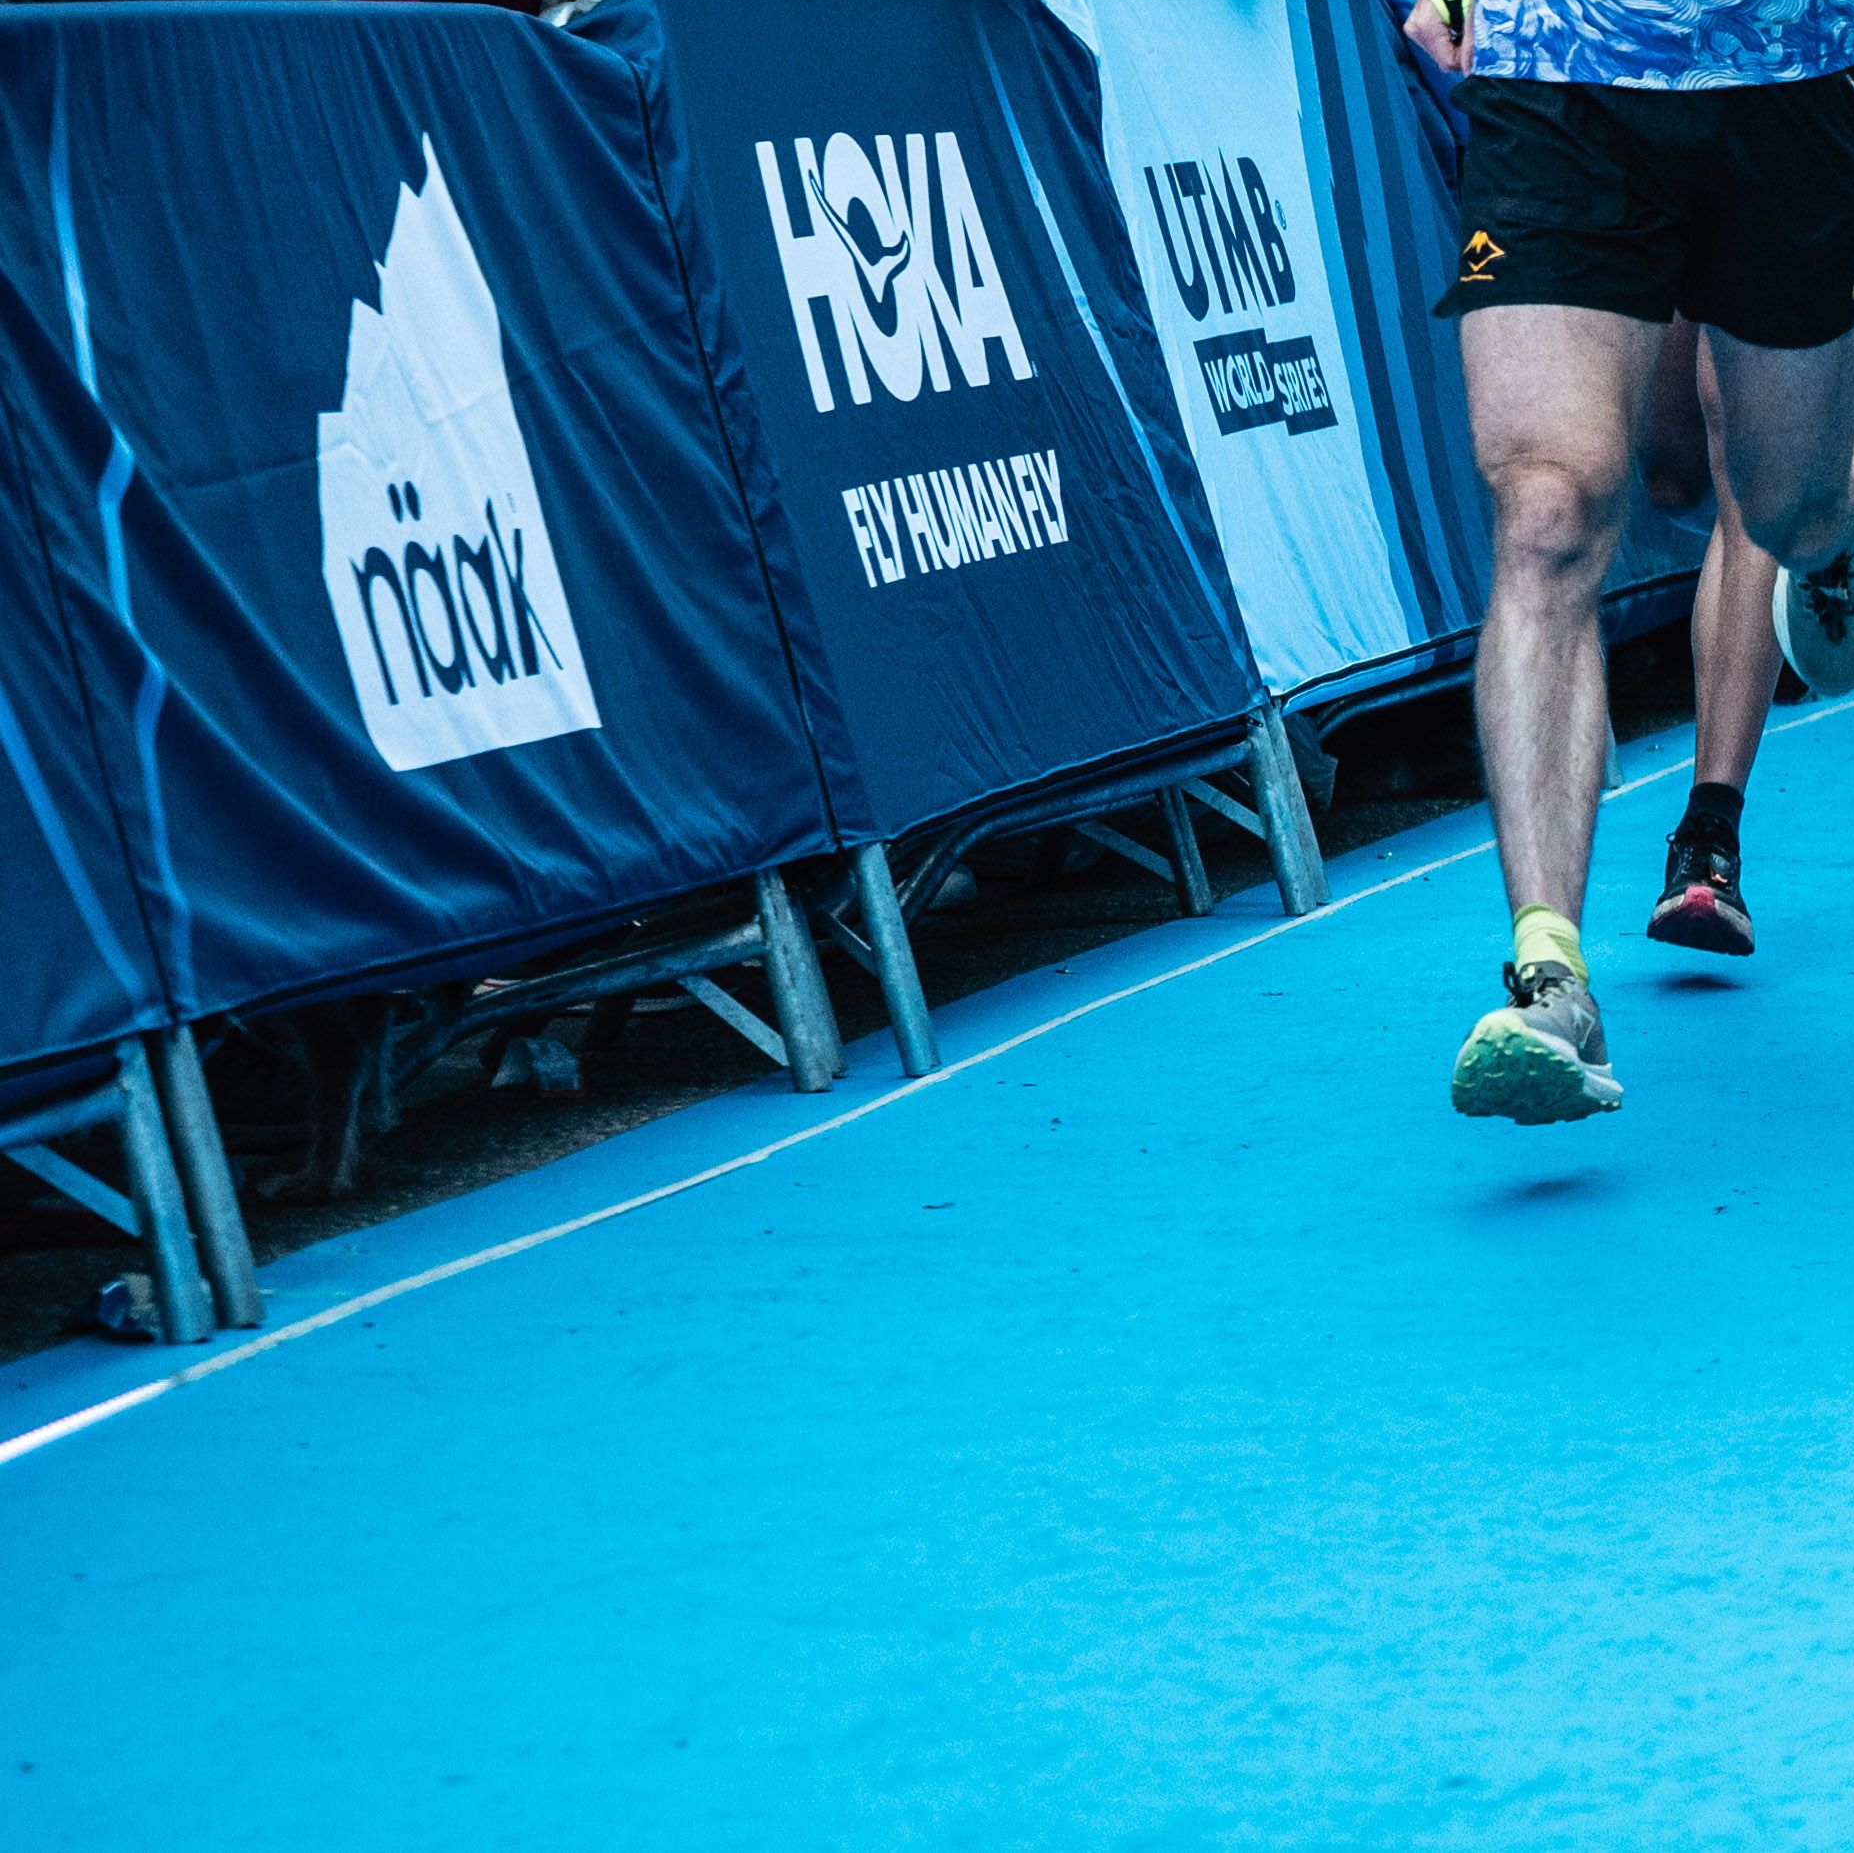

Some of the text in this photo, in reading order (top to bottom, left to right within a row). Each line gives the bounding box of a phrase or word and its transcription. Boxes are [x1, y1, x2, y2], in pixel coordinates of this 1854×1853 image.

[756, 132, 1032, 412] HOKA
[1143, 146, 1296, 323] UTMB
[1204, 351, 1274, 414] WORLD
[350, 482, 562, 705] näak
[842, 449, 1069, 588] FLY HUMAN FLY
